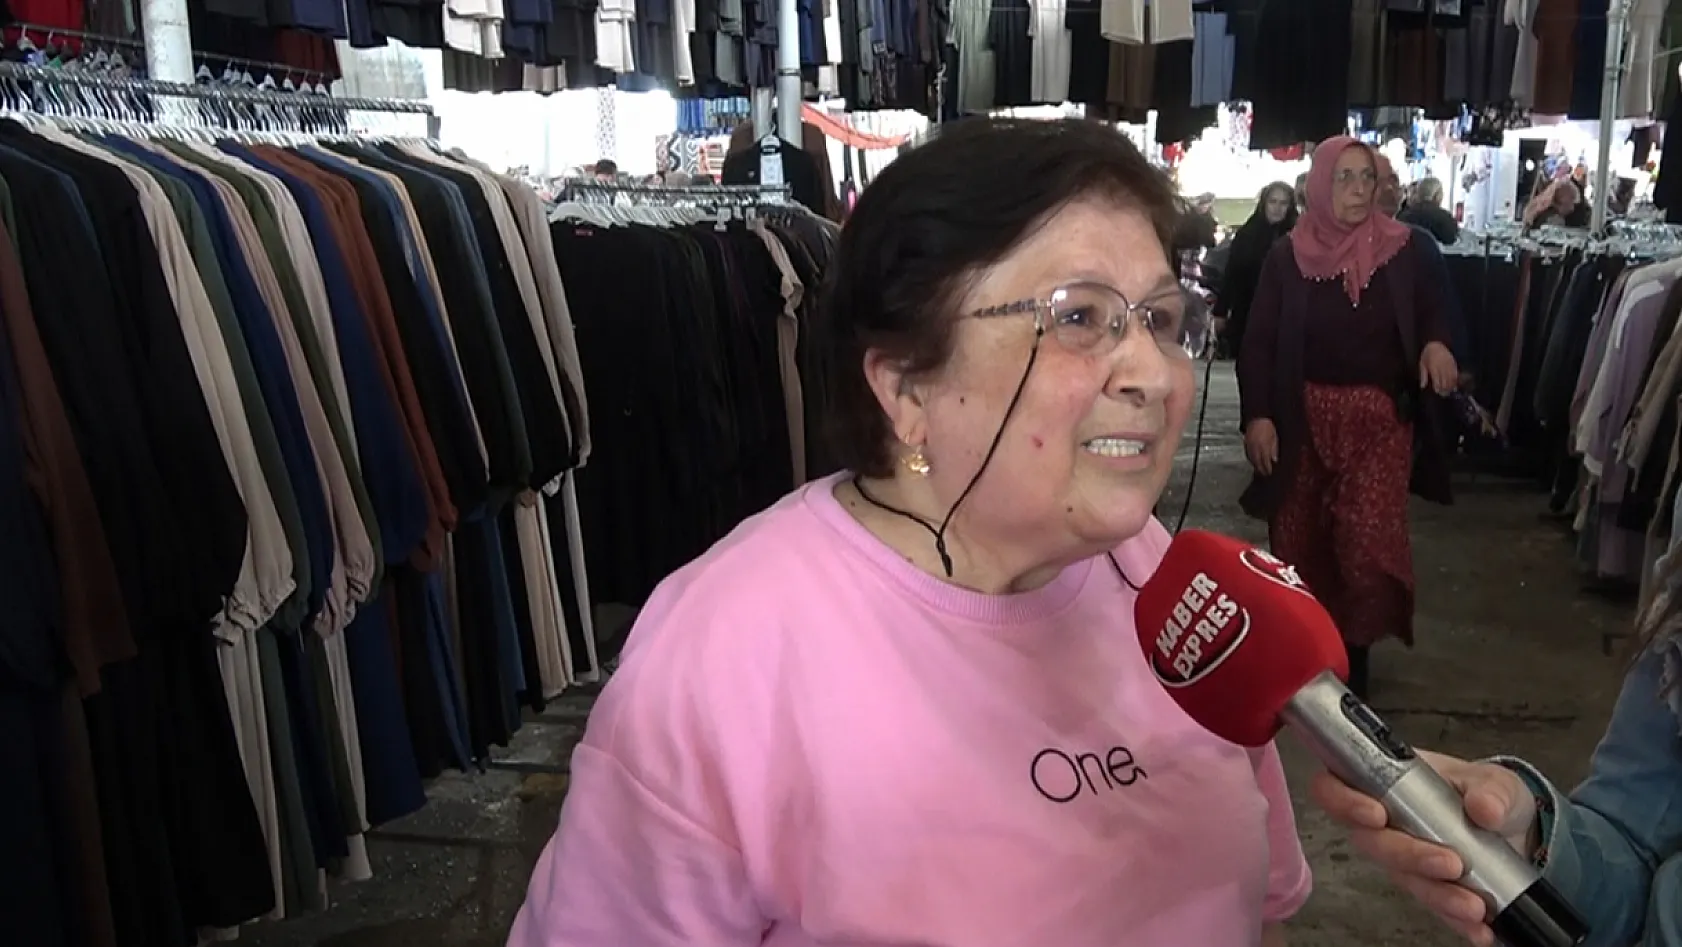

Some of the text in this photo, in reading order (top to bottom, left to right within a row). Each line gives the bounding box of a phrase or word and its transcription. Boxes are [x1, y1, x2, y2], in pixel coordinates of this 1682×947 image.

[1156, 572, 1218, 657] HABER
[1173, 593, 1237, 679] EXPRES
[1031, 746, 1148, 803] One
